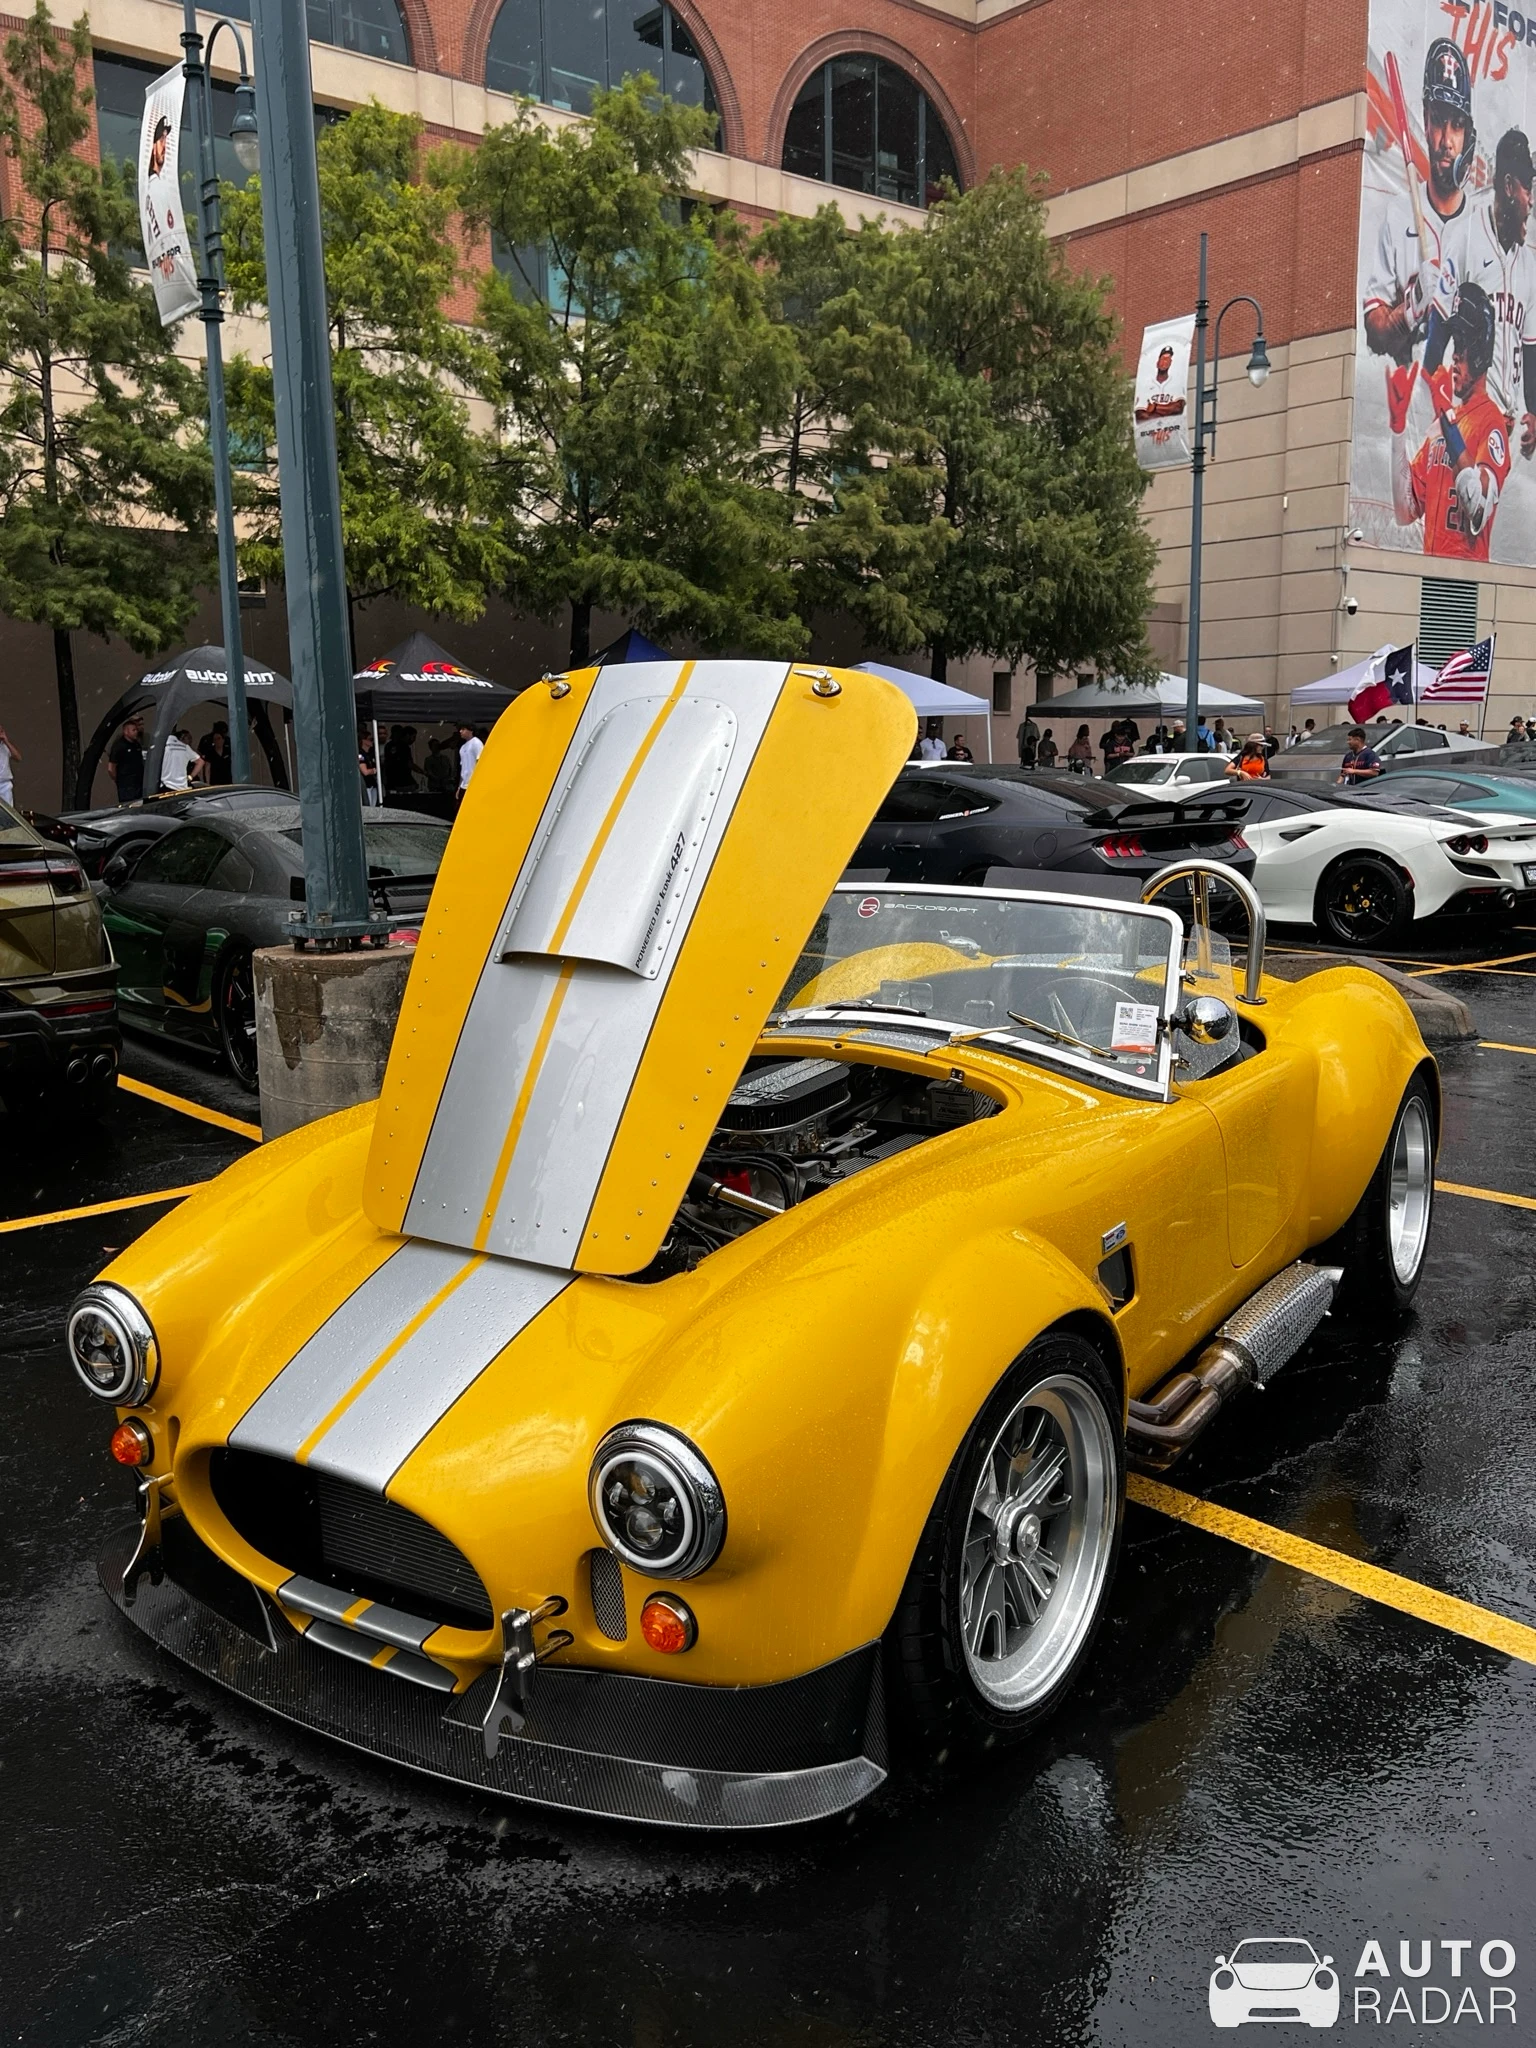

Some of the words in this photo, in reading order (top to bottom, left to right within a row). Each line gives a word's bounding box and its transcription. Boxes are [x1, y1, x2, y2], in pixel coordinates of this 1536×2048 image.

[1440, 2, 1516, 88] THIS
[185, 669, 274, 683] autohn
[400, 672, 493, 688] autobahn
[635, 916, 657, 968] POWERED
[670, 831, 686, 871] 427
[883, 903, 979, 914] BACKDRAFT
[731, 1089, 790, 1101] onic
